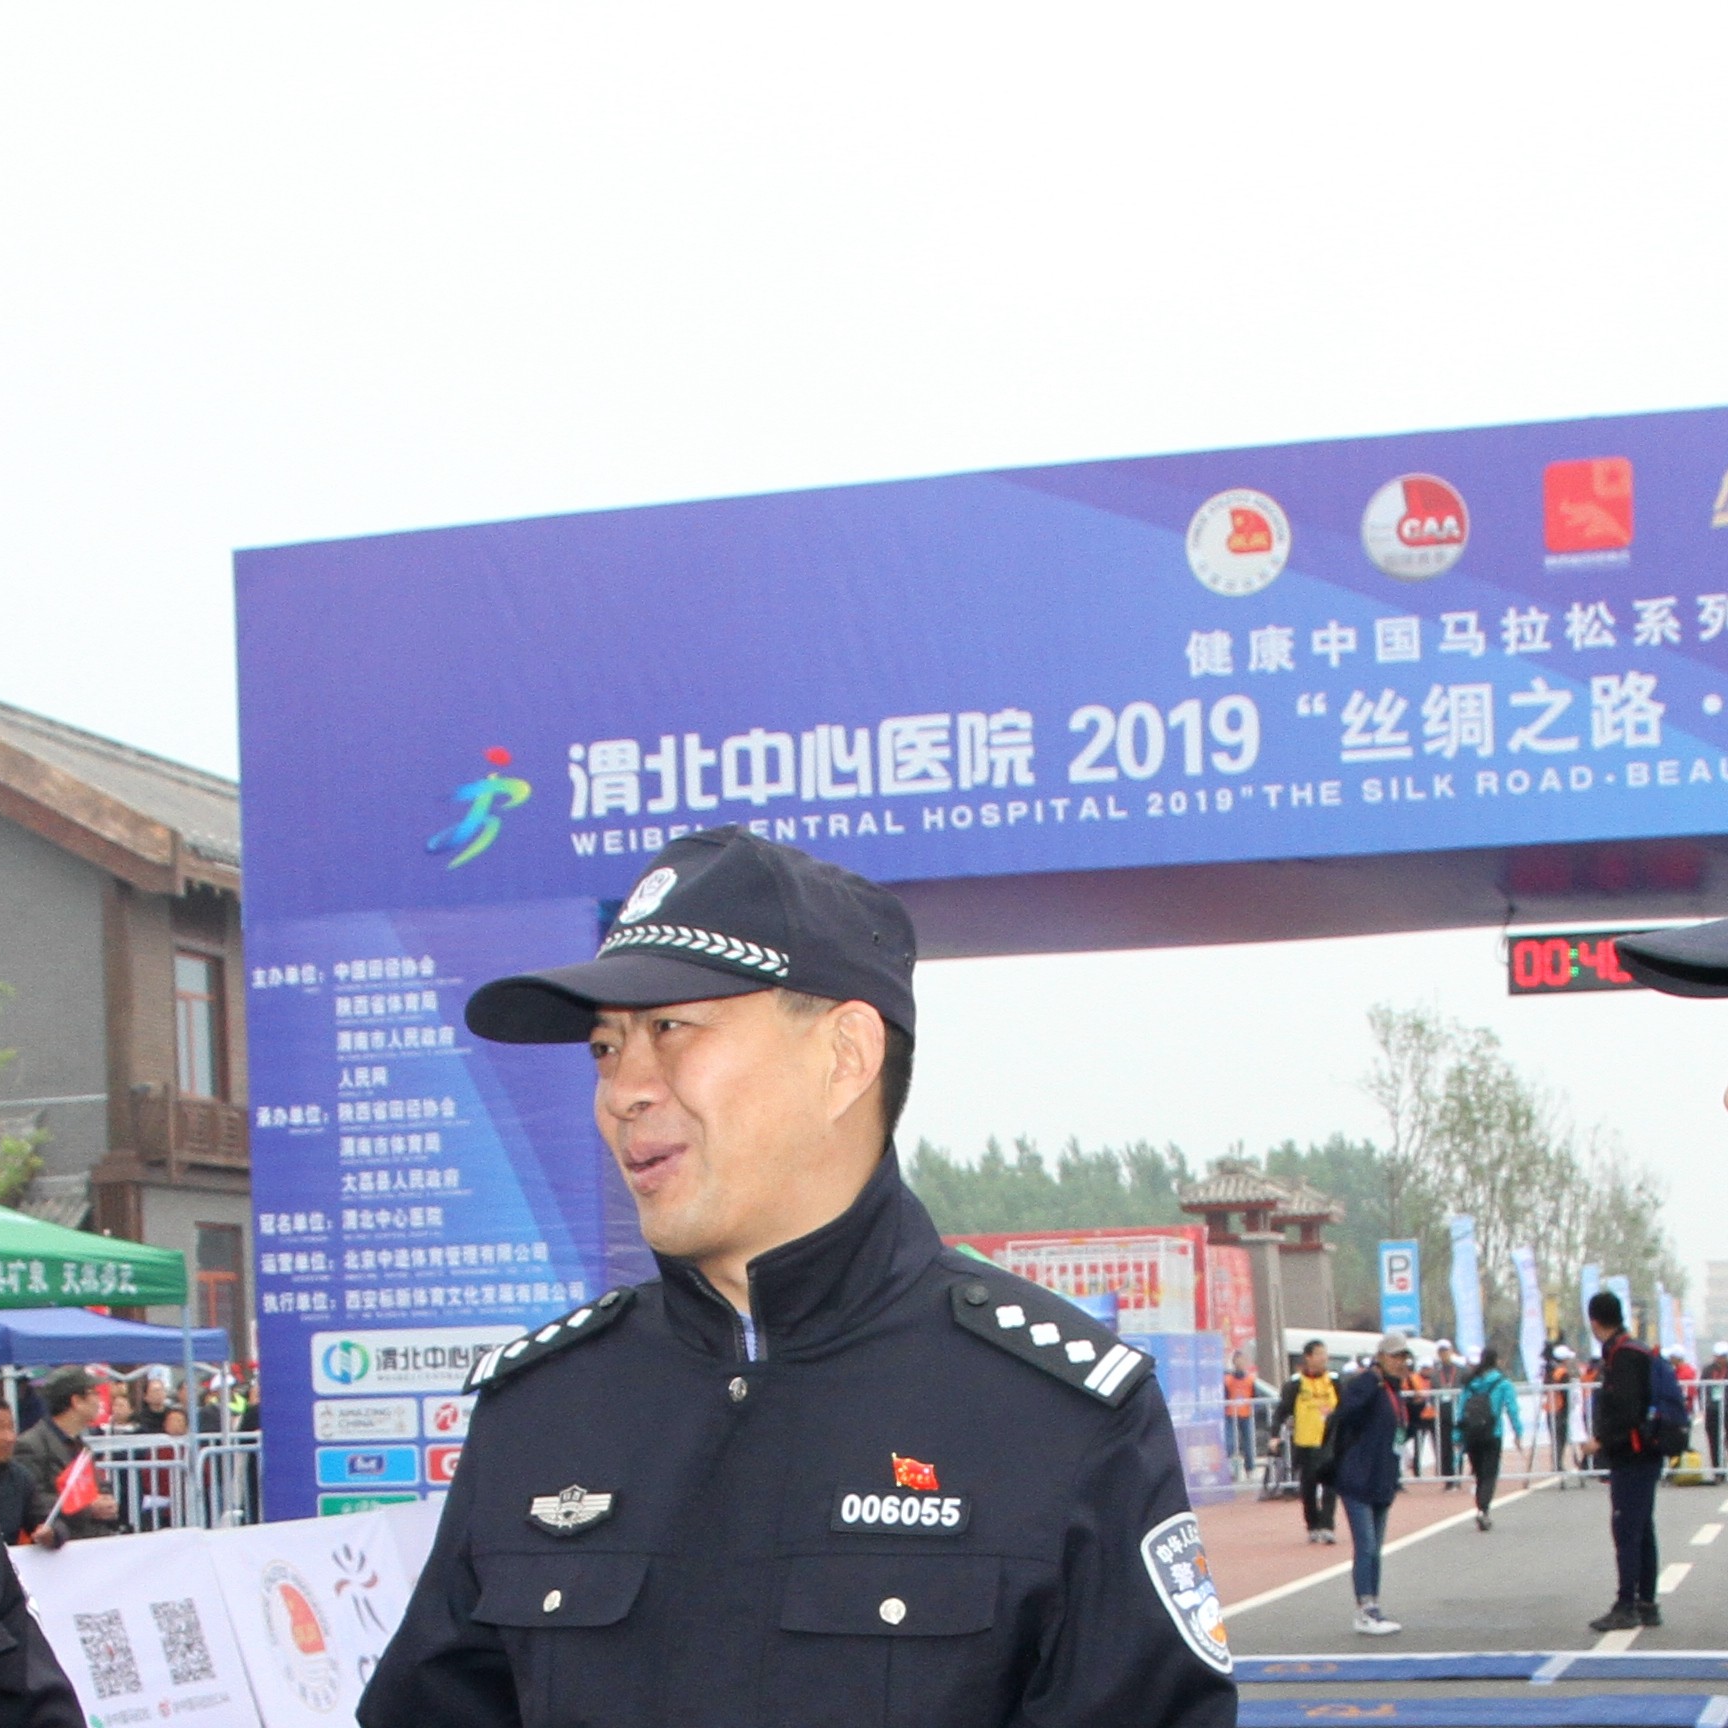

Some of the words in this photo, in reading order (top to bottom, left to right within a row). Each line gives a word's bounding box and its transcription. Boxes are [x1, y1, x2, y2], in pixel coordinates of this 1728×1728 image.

[568, 707, 1037, 821] 渭北中心医院
[1068, 694, 1261, 784] 2019
[570, 823, 704, 857] WEIBE
[726, 809, 906, 842] ENTRAL
[923, 794, 1127, 831] HOSPITAL
[1360, 773, 1457, 804] SILK
[1386, 1254, 1411, 1286] P
[376, 1342, 504, 1372] 渭北中心医
[841, 1493, 962, 1527] 006055
